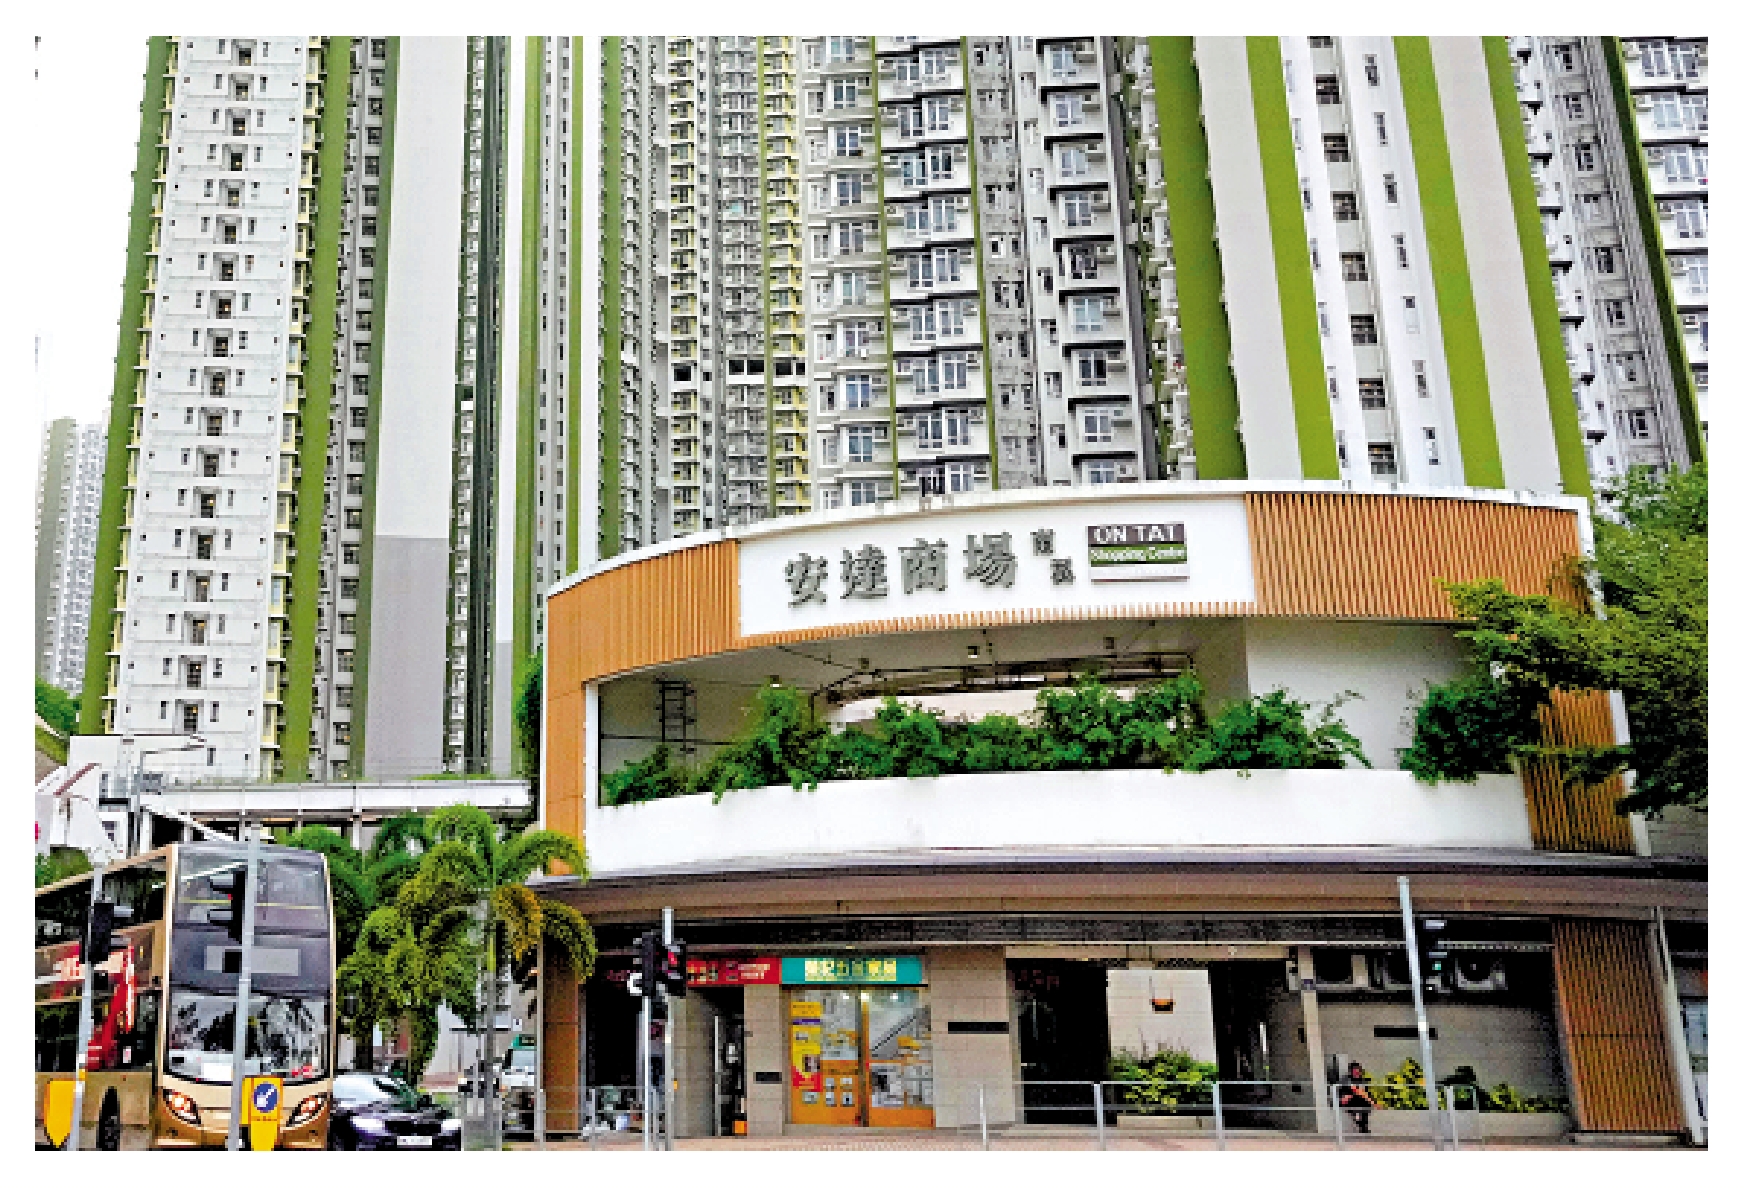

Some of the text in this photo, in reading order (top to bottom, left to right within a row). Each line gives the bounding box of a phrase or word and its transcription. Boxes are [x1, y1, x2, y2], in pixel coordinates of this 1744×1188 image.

[1093, 525, 1127, 544] ON
[783, 532, 1019, 608] 安達商場
